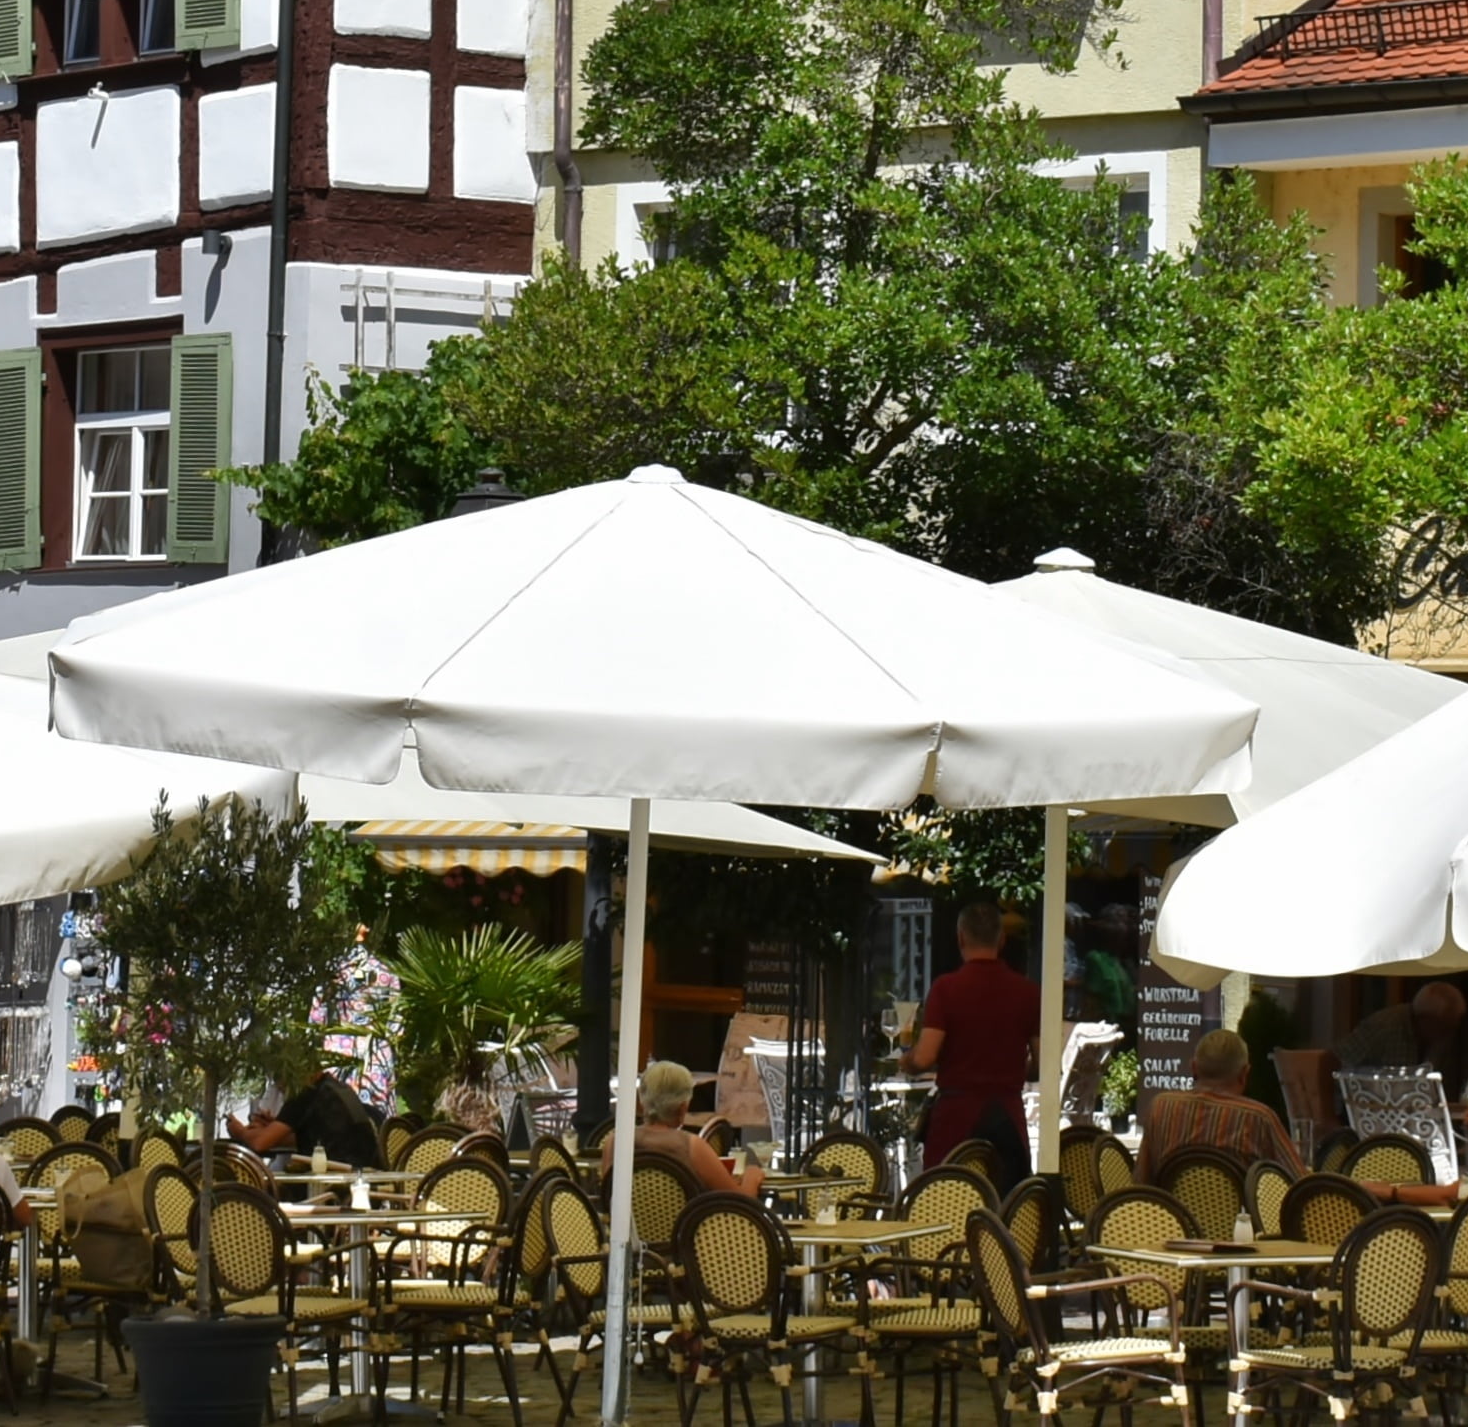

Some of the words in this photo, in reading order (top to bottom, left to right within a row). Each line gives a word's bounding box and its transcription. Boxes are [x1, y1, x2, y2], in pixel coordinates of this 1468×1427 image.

[1144, 1027, 1190, 1042] FORELLE
[1143, 1058, 1181, 1072] SALAT
[1144, 1076, 1193, 1091] CAPRESE
